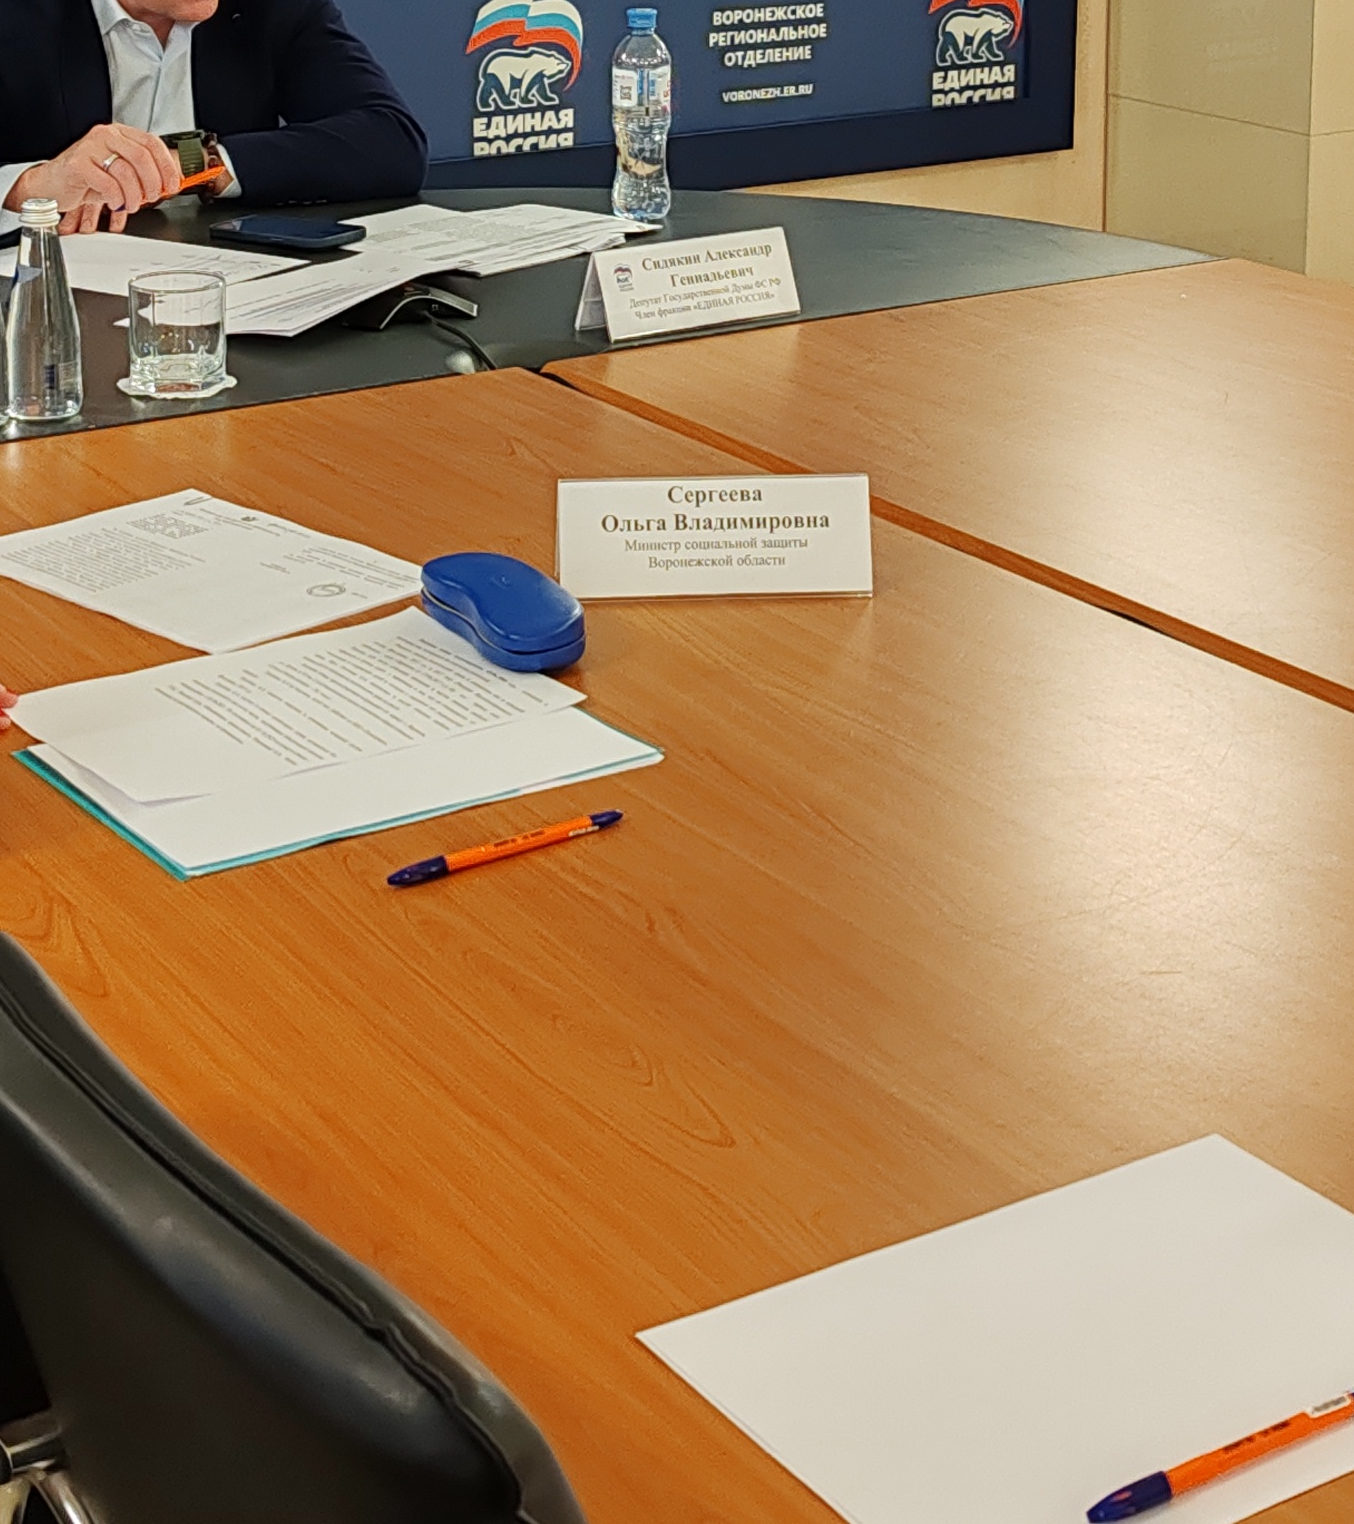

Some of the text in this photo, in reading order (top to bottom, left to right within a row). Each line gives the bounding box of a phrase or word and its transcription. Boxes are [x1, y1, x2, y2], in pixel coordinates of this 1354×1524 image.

[712, 2, 825, 26] ВОРОНЕЖСКОЕ
[708, 23, 827, 48] РЕГИОНАЛЬНОЕ
[723, 44, 812, 68] ОТДЕЛЕНИЕ
[932, 64, 1015, 91] ЕДИНАЯ
[722, 83, 814, 103] VORONEZH.ER.RU
[473, 108, 574, 139] ЕДИНАЯ
[642, 244, 772, 271] Сидякин Александр
[667, 485, 763, 507] Сергеева
[601, 513, 830, 534] Ольга Владимировна
[624, 537, 808, 553] Министр социальной защиты
[648, 555, 785, 570] Воронежской области
